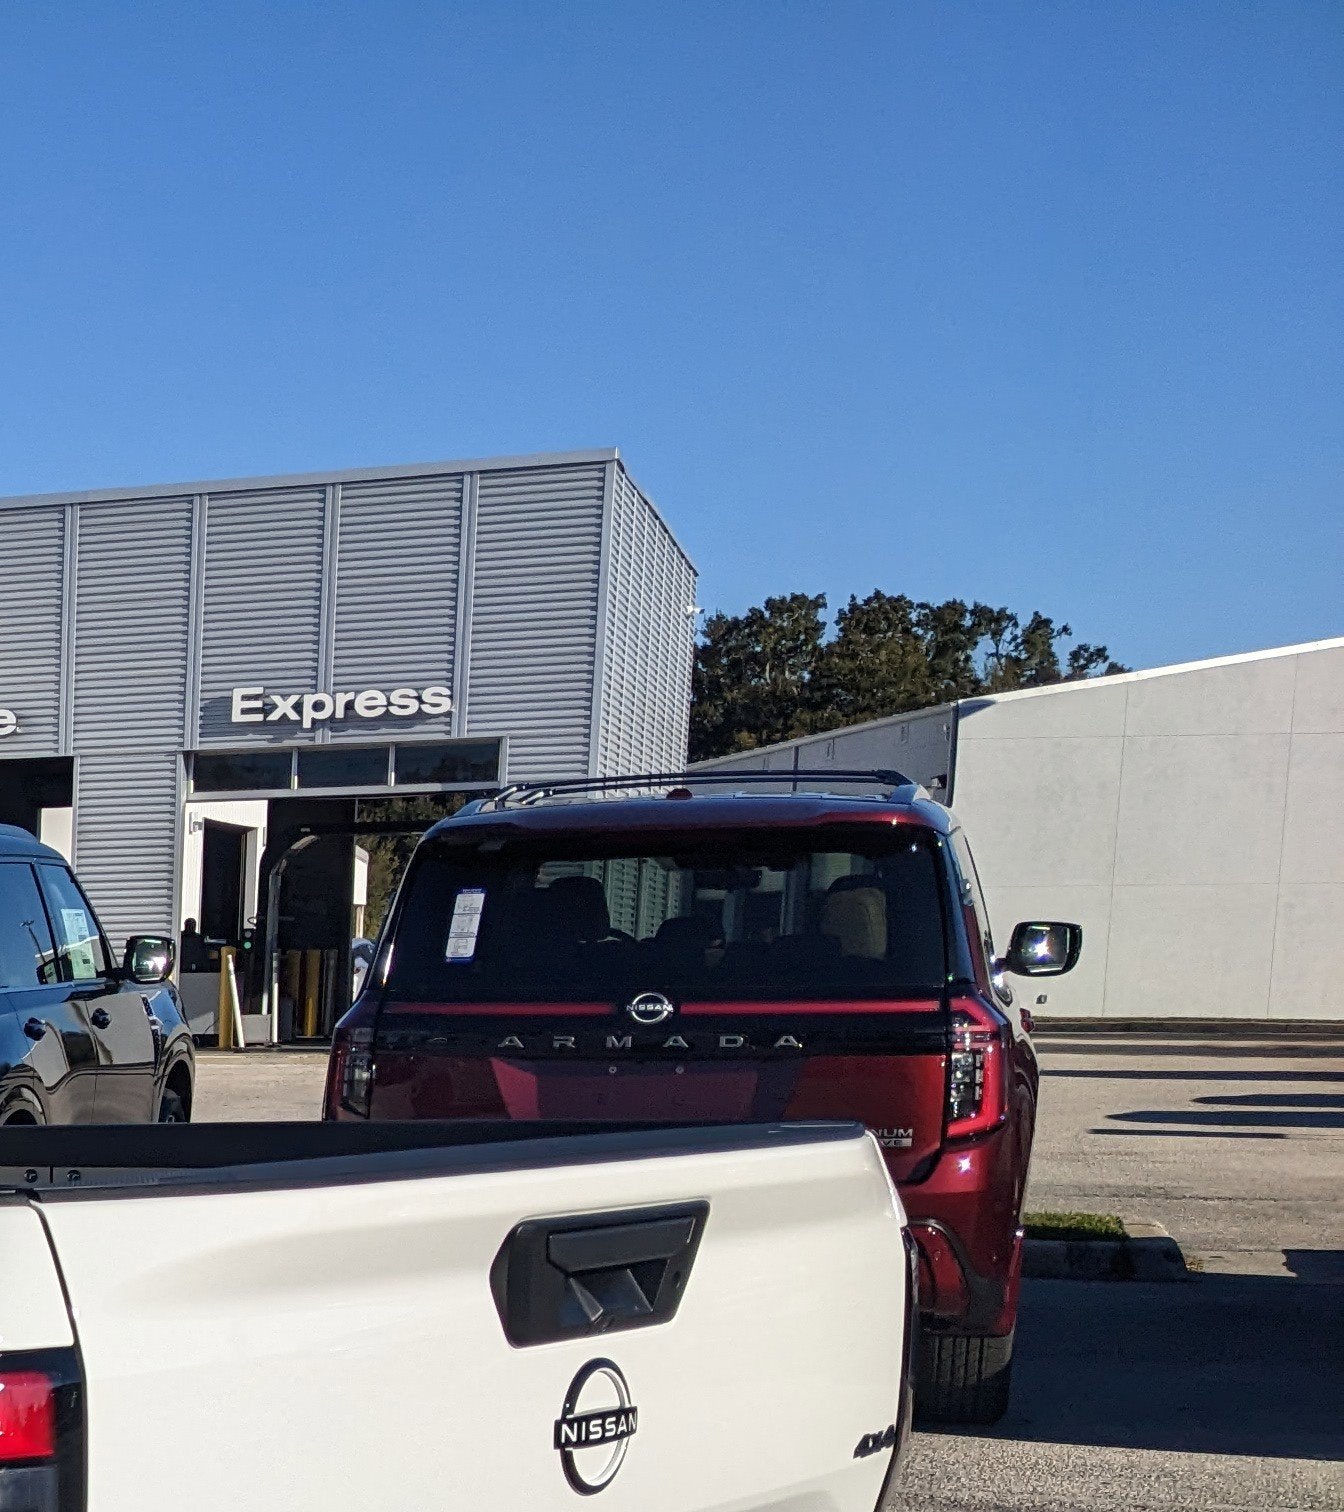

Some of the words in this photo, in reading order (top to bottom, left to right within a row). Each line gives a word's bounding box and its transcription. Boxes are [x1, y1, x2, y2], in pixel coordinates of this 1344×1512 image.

[231, 686, 452, 729] Express
[626, 1003, 674, 1013] NISSAN
[497, 1035, 802, 1049] ARMADA
[561, 1411, 638, 1444] NISSAN
